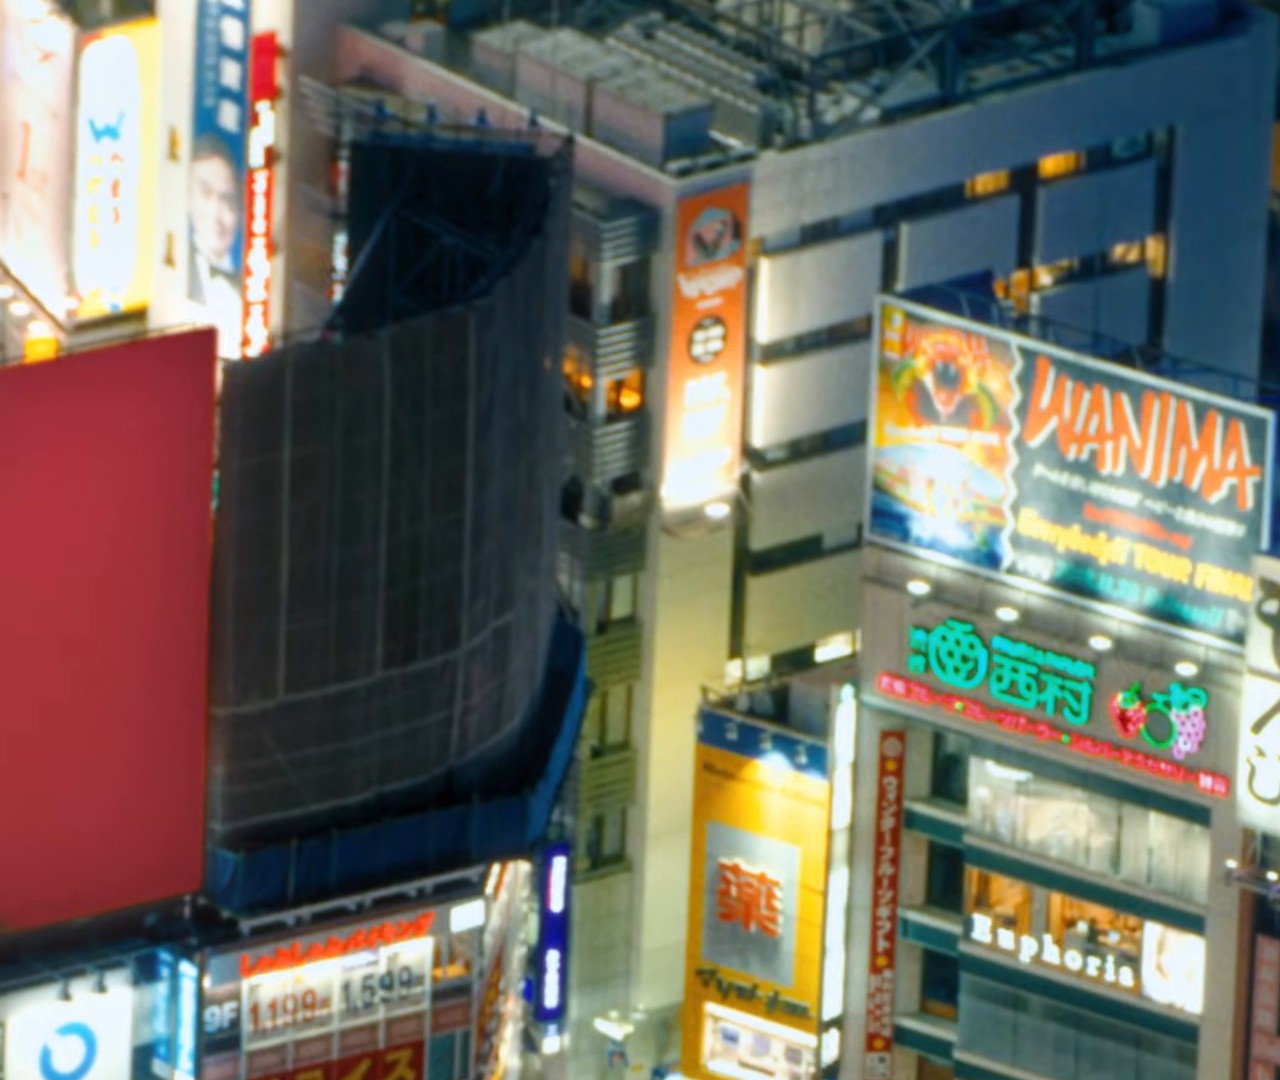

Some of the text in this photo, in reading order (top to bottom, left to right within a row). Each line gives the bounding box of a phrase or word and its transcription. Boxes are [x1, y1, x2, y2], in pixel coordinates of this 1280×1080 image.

[1023, 355, 1261, 511] WANIMA
[989, 653, 1092, 727] 西村
[970, 911, 1136, 989] Euphoria
[203, 1001, 239, 1033] 9F
